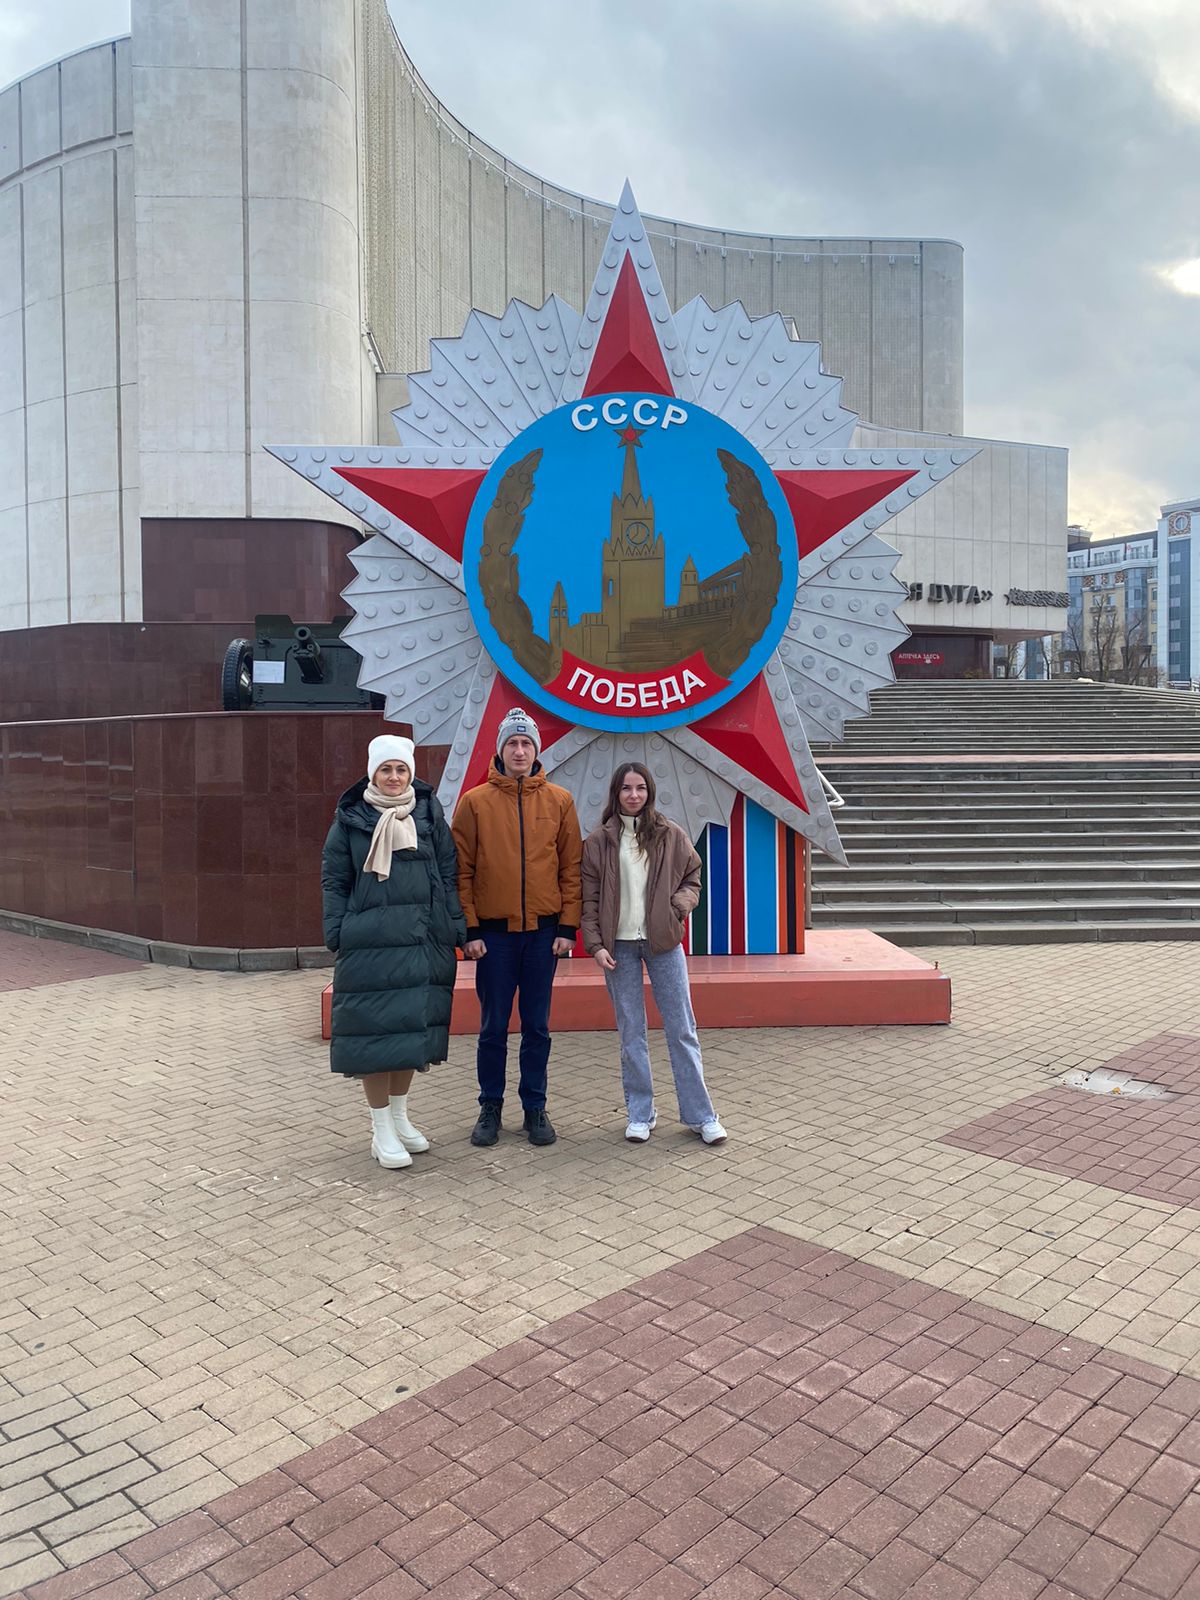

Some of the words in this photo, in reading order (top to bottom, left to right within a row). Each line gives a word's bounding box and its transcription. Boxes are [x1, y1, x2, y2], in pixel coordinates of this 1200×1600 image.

[571, 398, 688, 431] СССР
[928, 583, 993, 604] ДУГА»
[567, 667, 706, 709] ПОБЕДА
